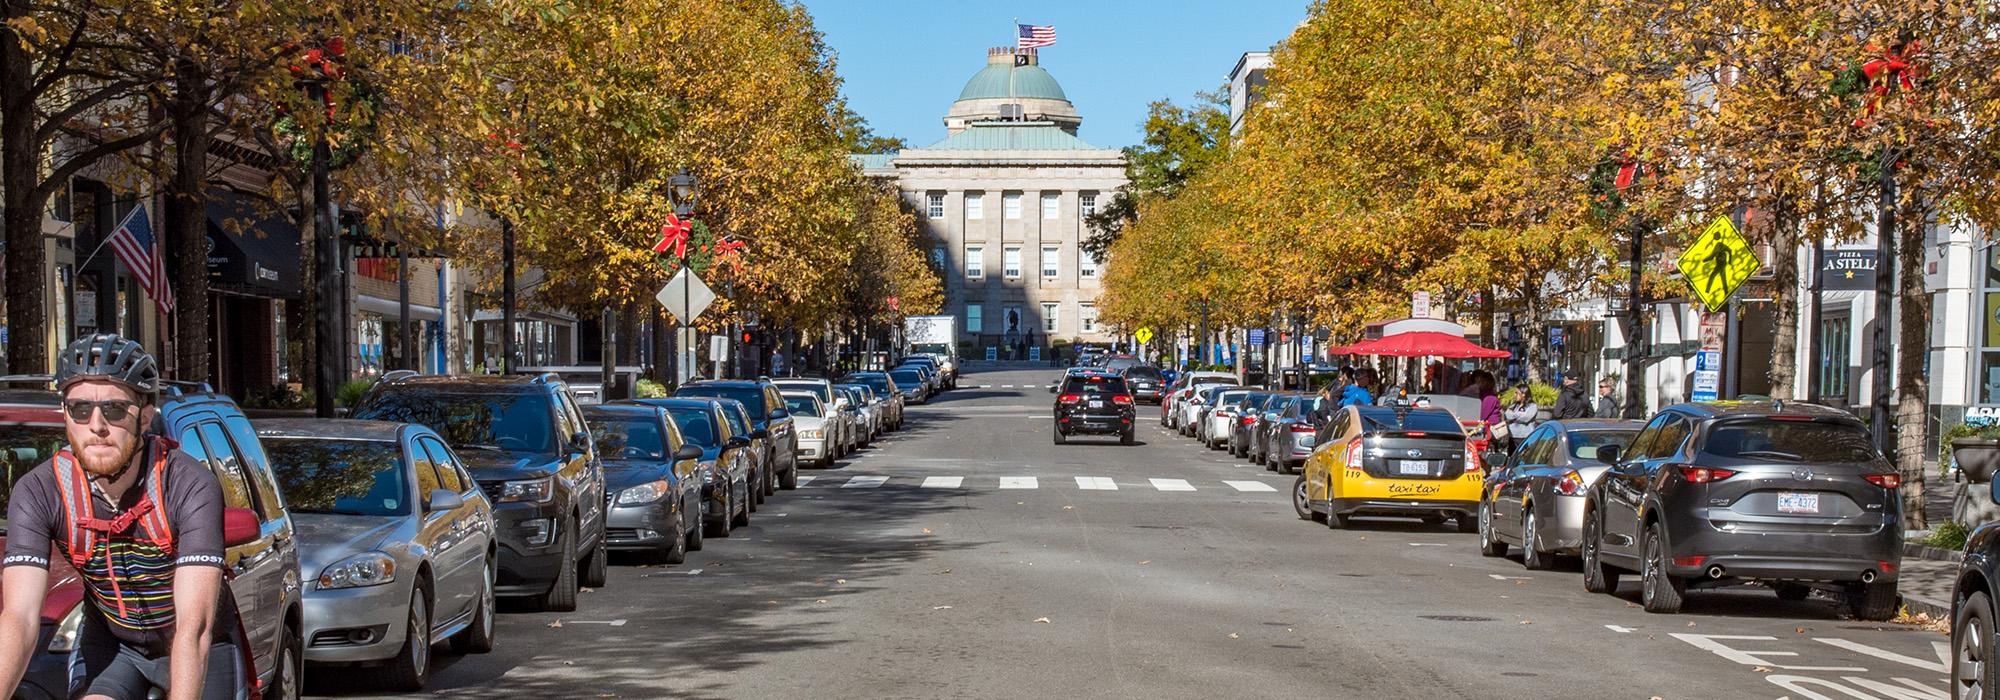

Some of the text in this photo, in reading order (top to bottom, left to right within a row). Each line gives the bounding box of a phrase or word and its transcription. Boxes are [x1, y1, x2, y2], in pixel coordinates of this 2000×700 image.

[1346, 470, 1361, 478] 119
[1467, 474, 1481, 482] 119
[1388, 483, 1441, 493] taxi taxi
